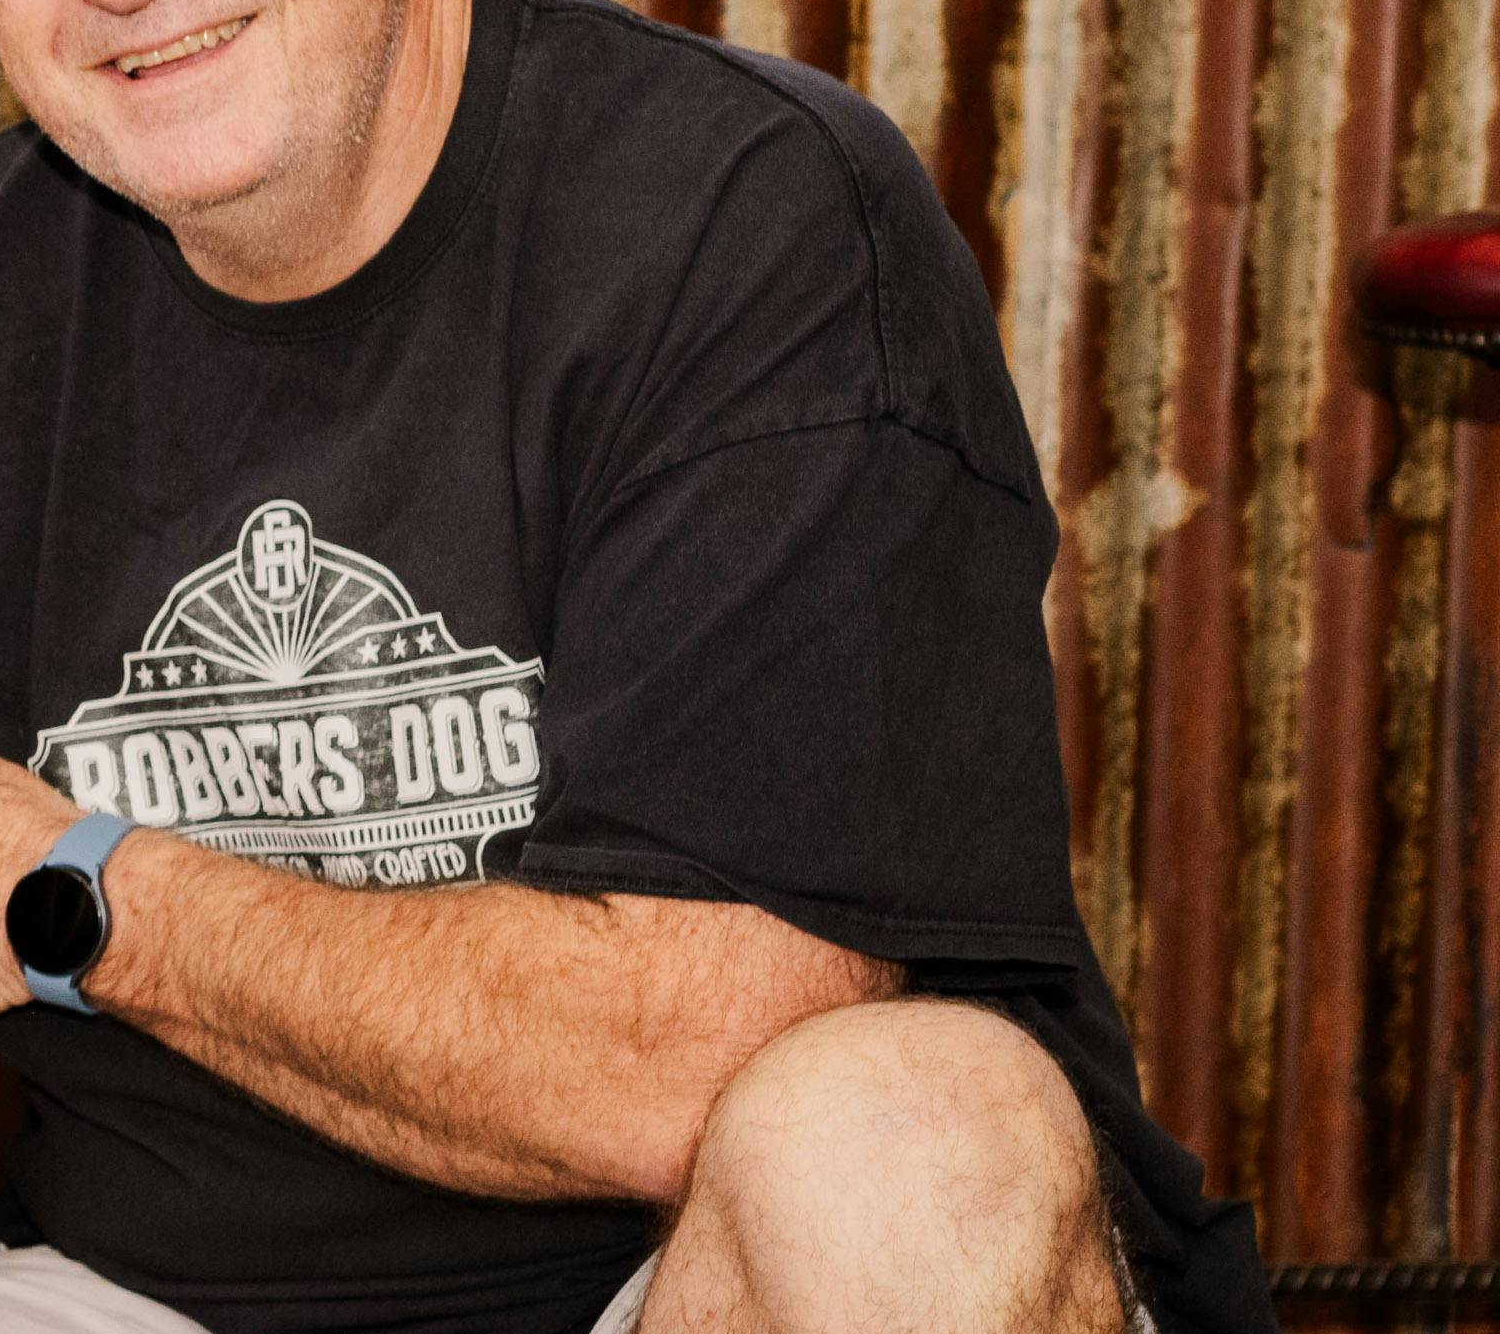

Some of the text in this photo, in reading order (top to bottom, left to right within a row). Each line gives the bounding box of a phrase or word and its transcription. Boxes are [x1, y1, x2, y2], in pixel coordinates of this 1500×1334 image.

[64, 687, 540, 827] ROBBERS DOG
[373, 842, 467, 886] CRAFTED
